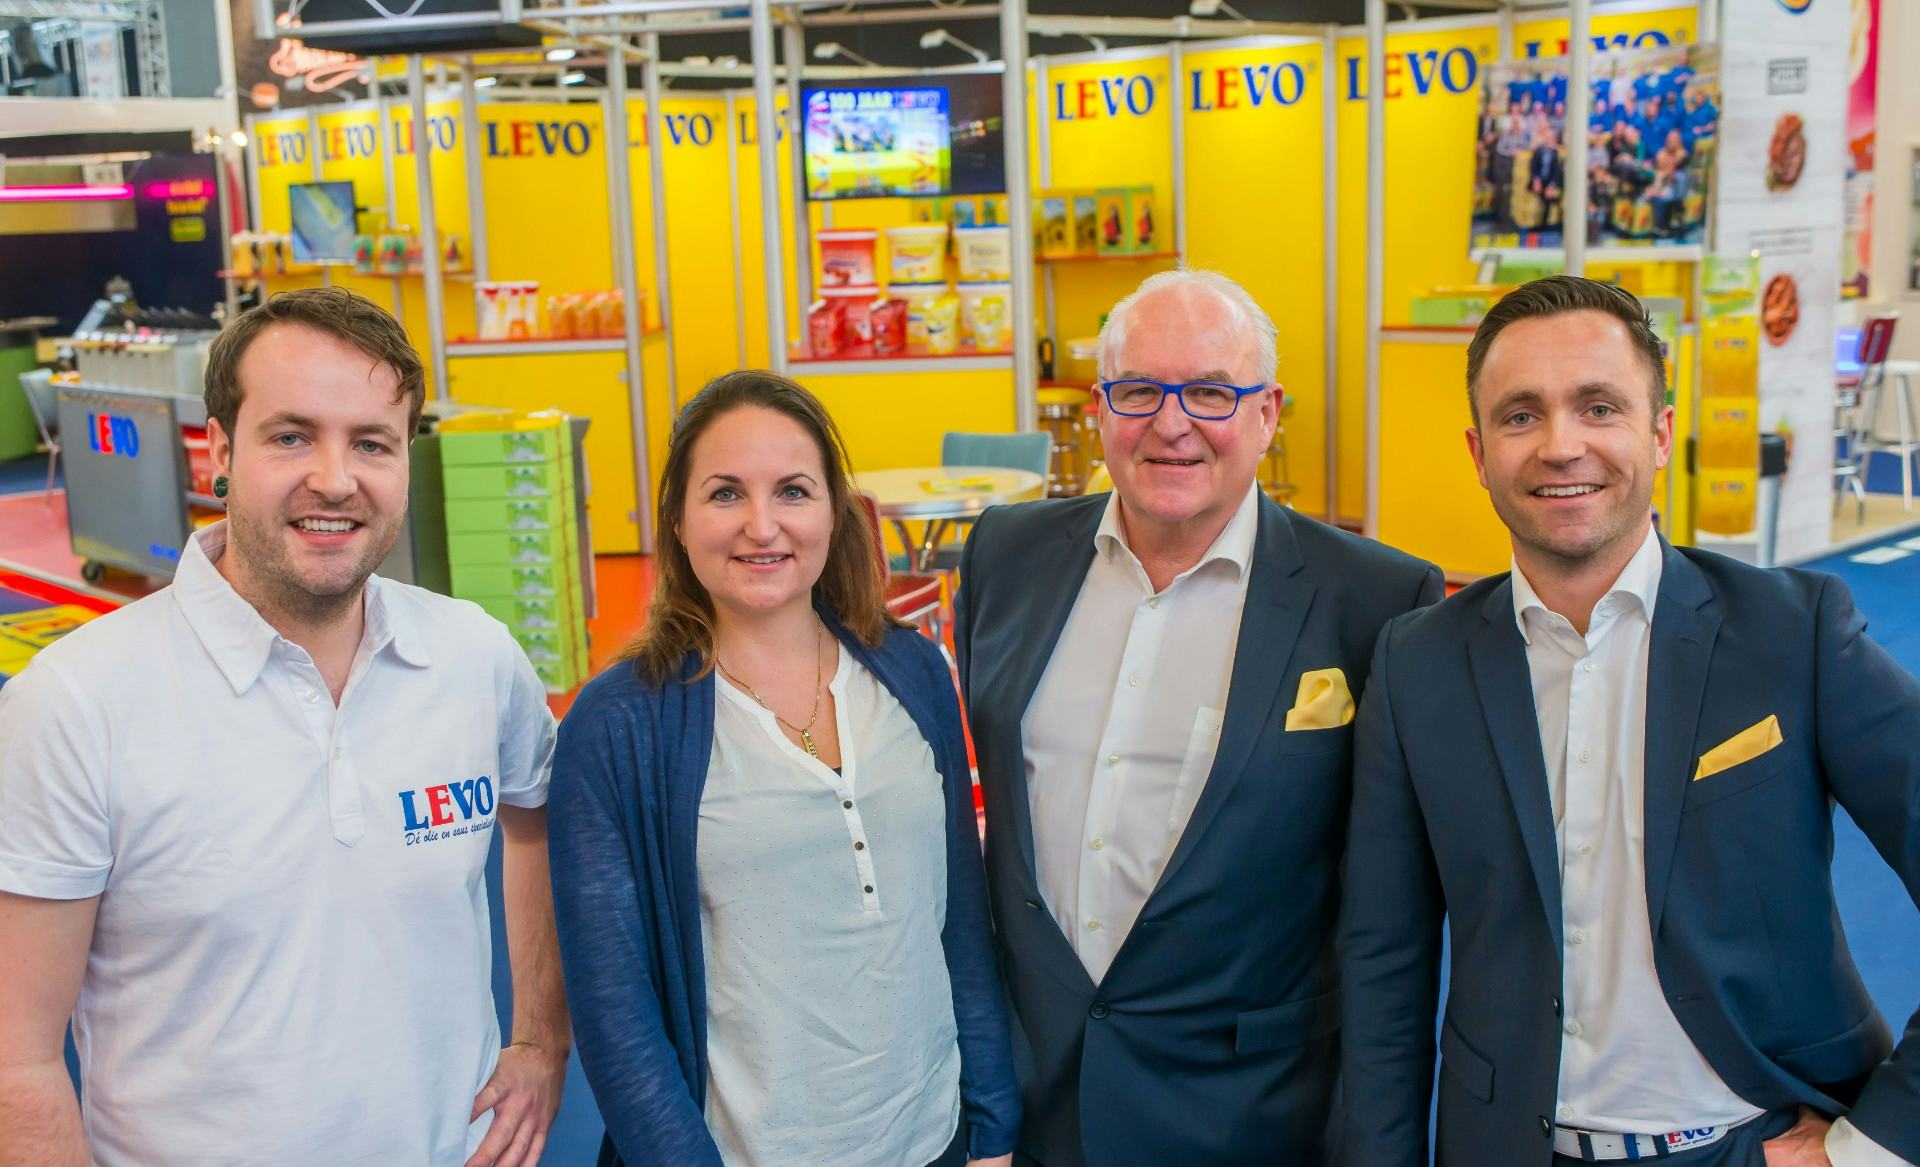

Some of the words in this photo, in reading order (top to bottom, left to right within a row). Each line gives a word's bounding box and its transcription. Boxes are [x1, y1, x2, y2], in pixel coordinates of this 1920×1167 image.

[1055, 75, 1155, 121] LEVO
[1190, 62, 1305, 112] LEVO
[256, 131, 306, 168] LEVO
[321, 124, 376, 162] LEVO
[486, 120, 591, 158] LEVO
[88, 413, 140, 459] LEVO
[398, 775, 494, 832] LEVO
[423, 830, 438, 843] olie
[441, 831, 450, 840] en
[453, 826, 468, 837] saus
